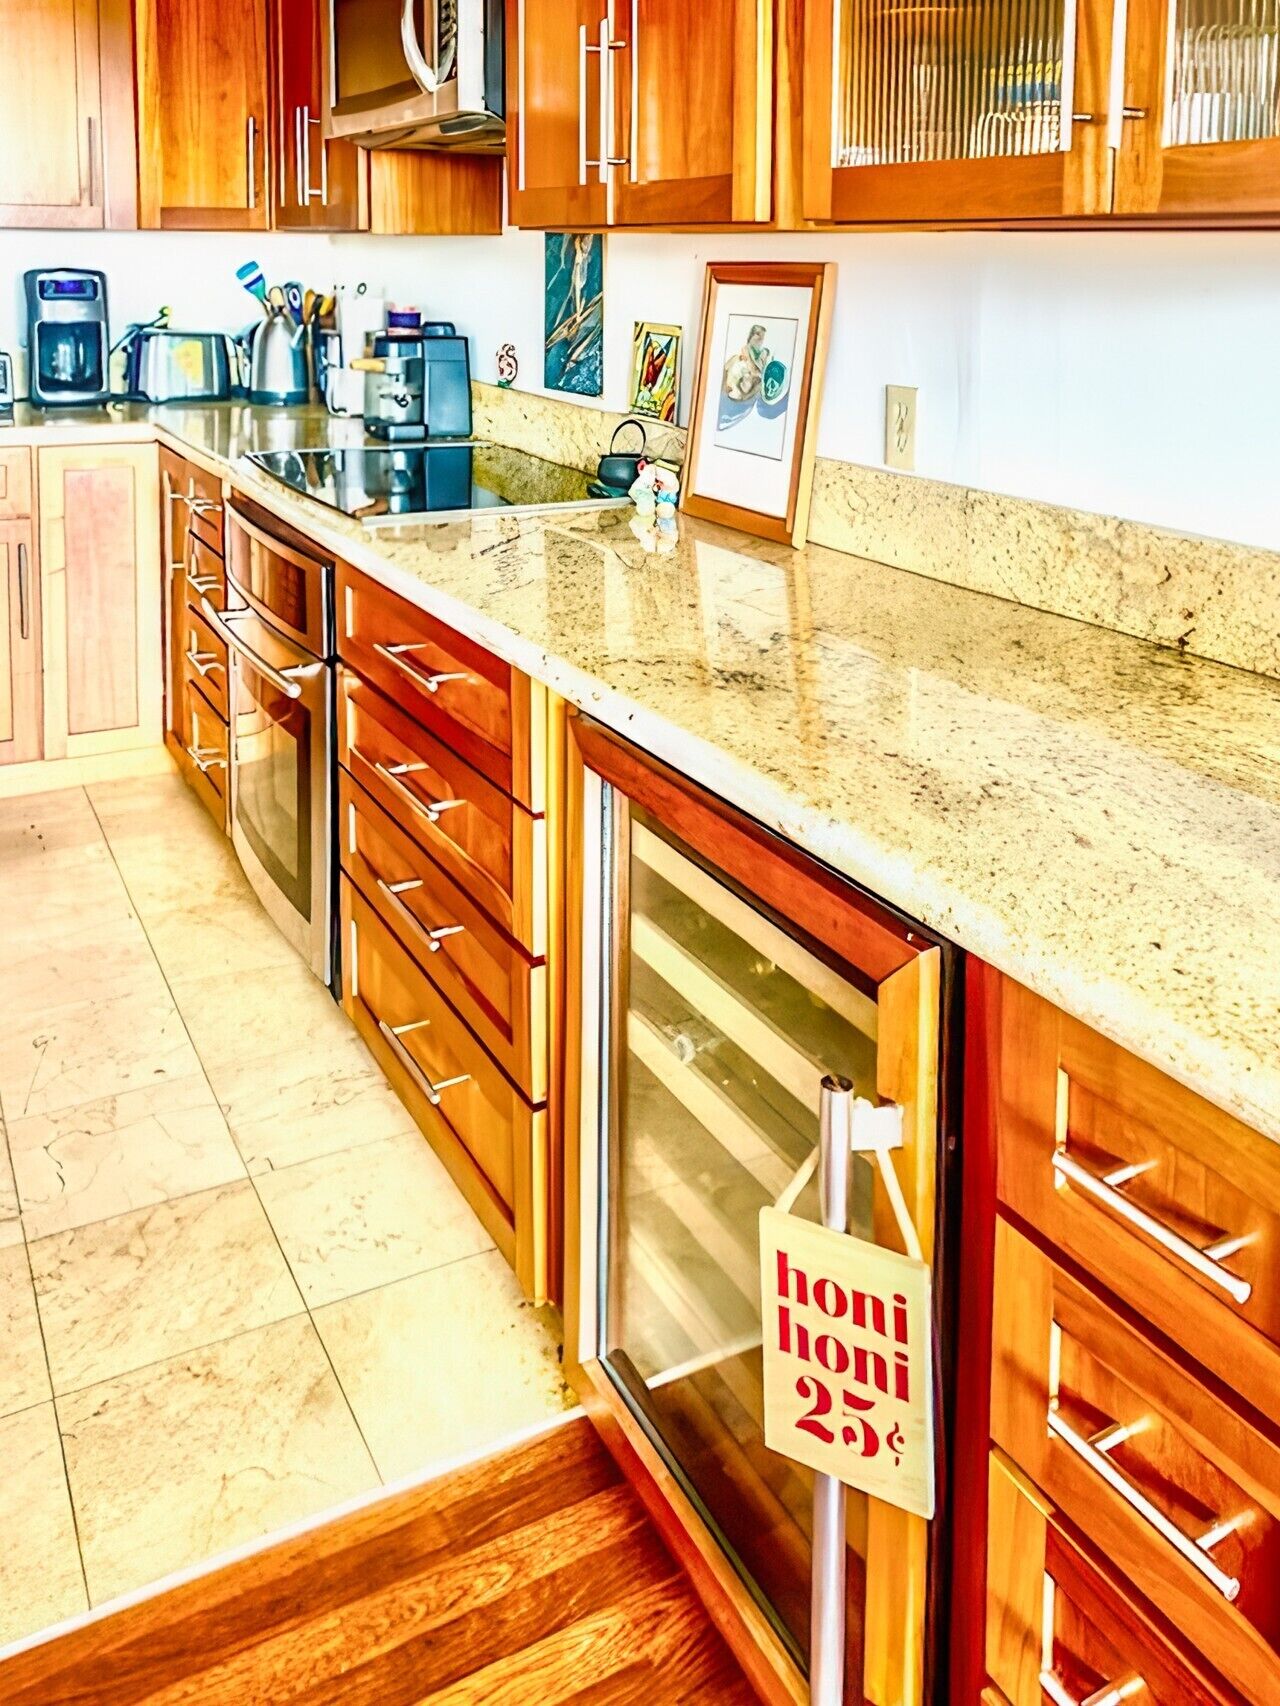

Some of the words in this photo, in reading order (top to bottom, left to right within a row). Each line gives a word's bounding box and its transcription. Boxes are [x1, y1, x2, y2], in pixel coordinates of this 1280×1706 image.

[777, 1250, 908, 1344] honi
[778, 1305, 909, 1402] honi
[795, 1376, 905, 1466] 25¢
